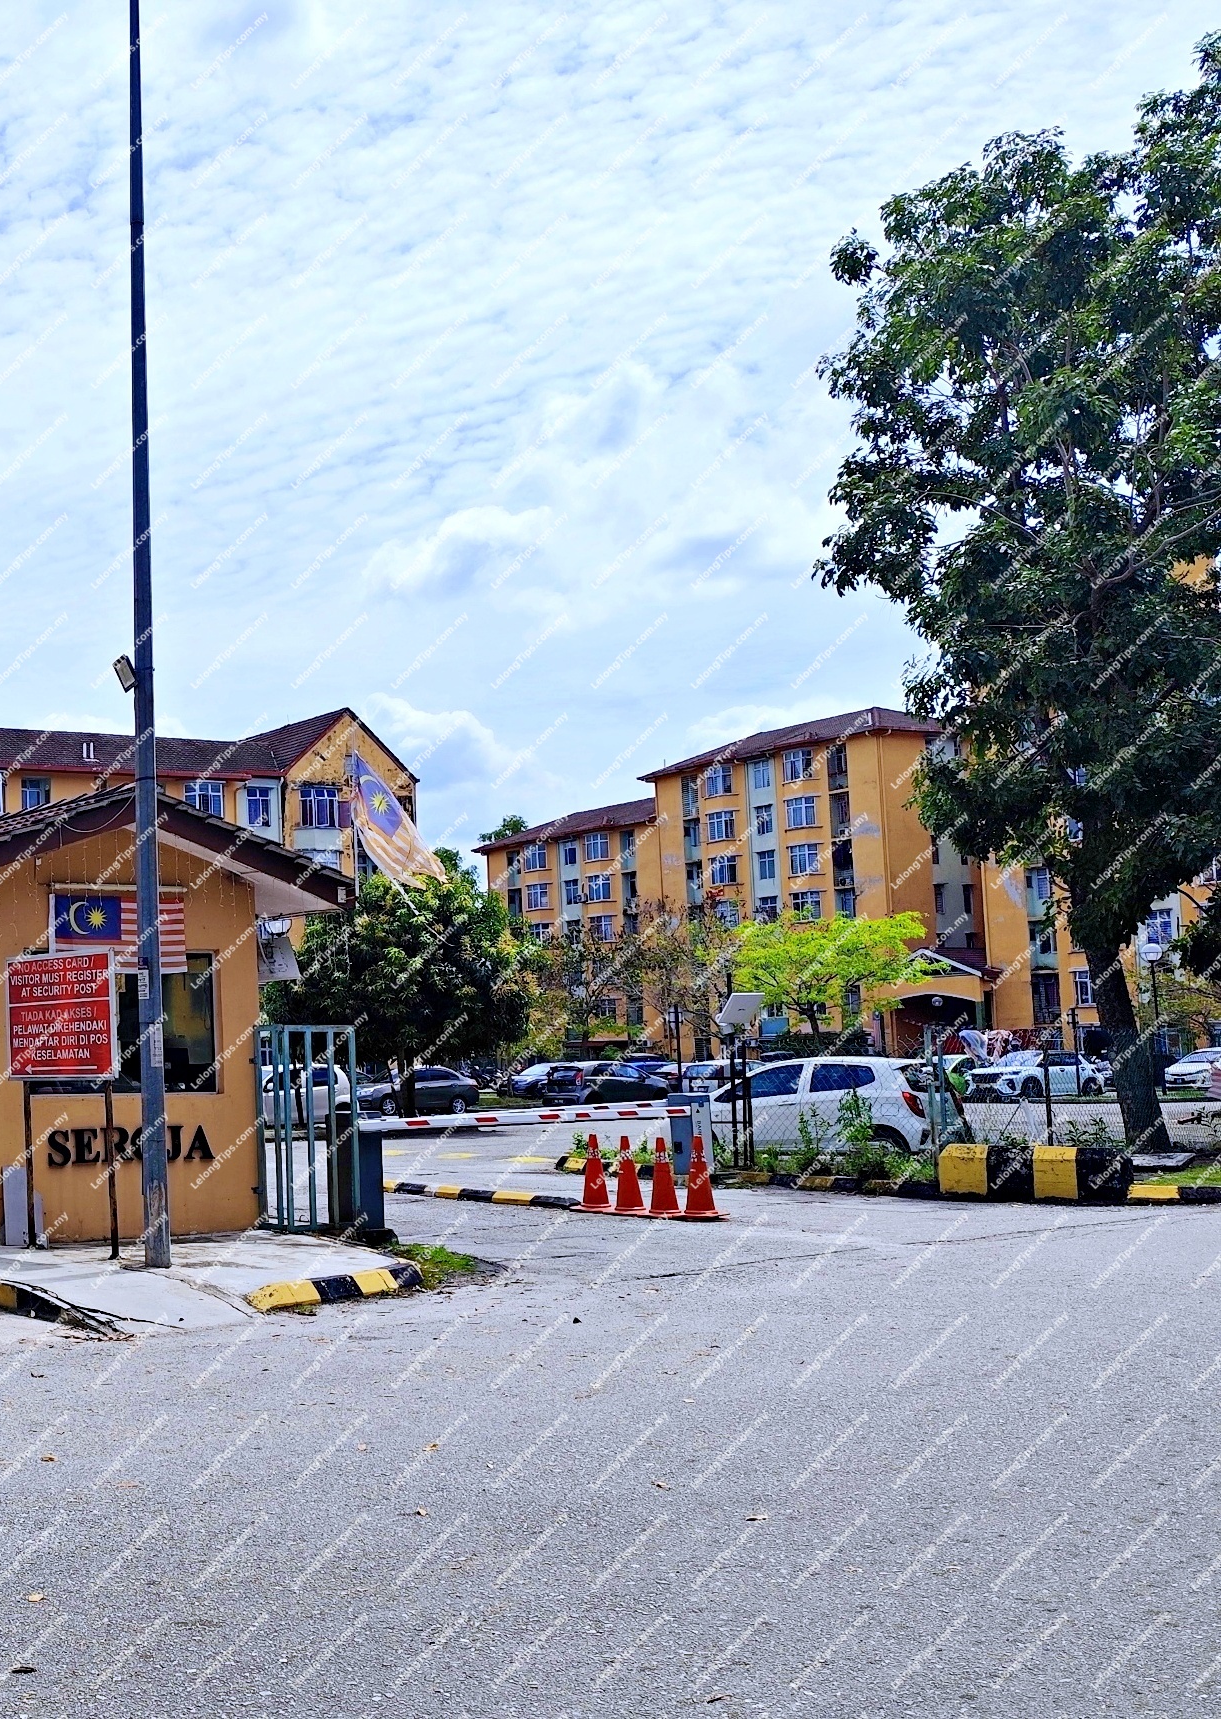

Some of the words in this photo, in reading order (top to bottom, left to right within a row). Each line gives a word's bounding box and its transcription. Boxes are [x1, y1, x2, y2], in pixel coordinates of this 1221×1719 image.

[19, 962, 30, 973] NO
[31, 959, 64, 972] ACCESS
[65, 957, 89, 969] CARD
[10, 973, 40, 986] VISITOR
[42, 971, 64, 984] MUST
[66, 969, 109, 982] REGISTER
[21, 987, 31, 997] AT
[32, 984, 72, 996] SECURITY
[74, 983, 96, 994] POST
[21, 1010, 44, 1022] TIADA
[45, 1009, 63, 1021] KAD
[64, 1007, 92, 1019] AKSES
[13, 1023, 47, 1035] PELAWAT
[51, 1020, 107, 1033] DIKEHENDAKI
[13, 1035, 59, 1048] MENDAFTAR
[61, 1035, 77, 1046] DIRI
[79, 1034, 88, 1045] DI
[90, 1033, 108, 1044] POS
[31, 1048, 90, 1061] KESELAMATAN
